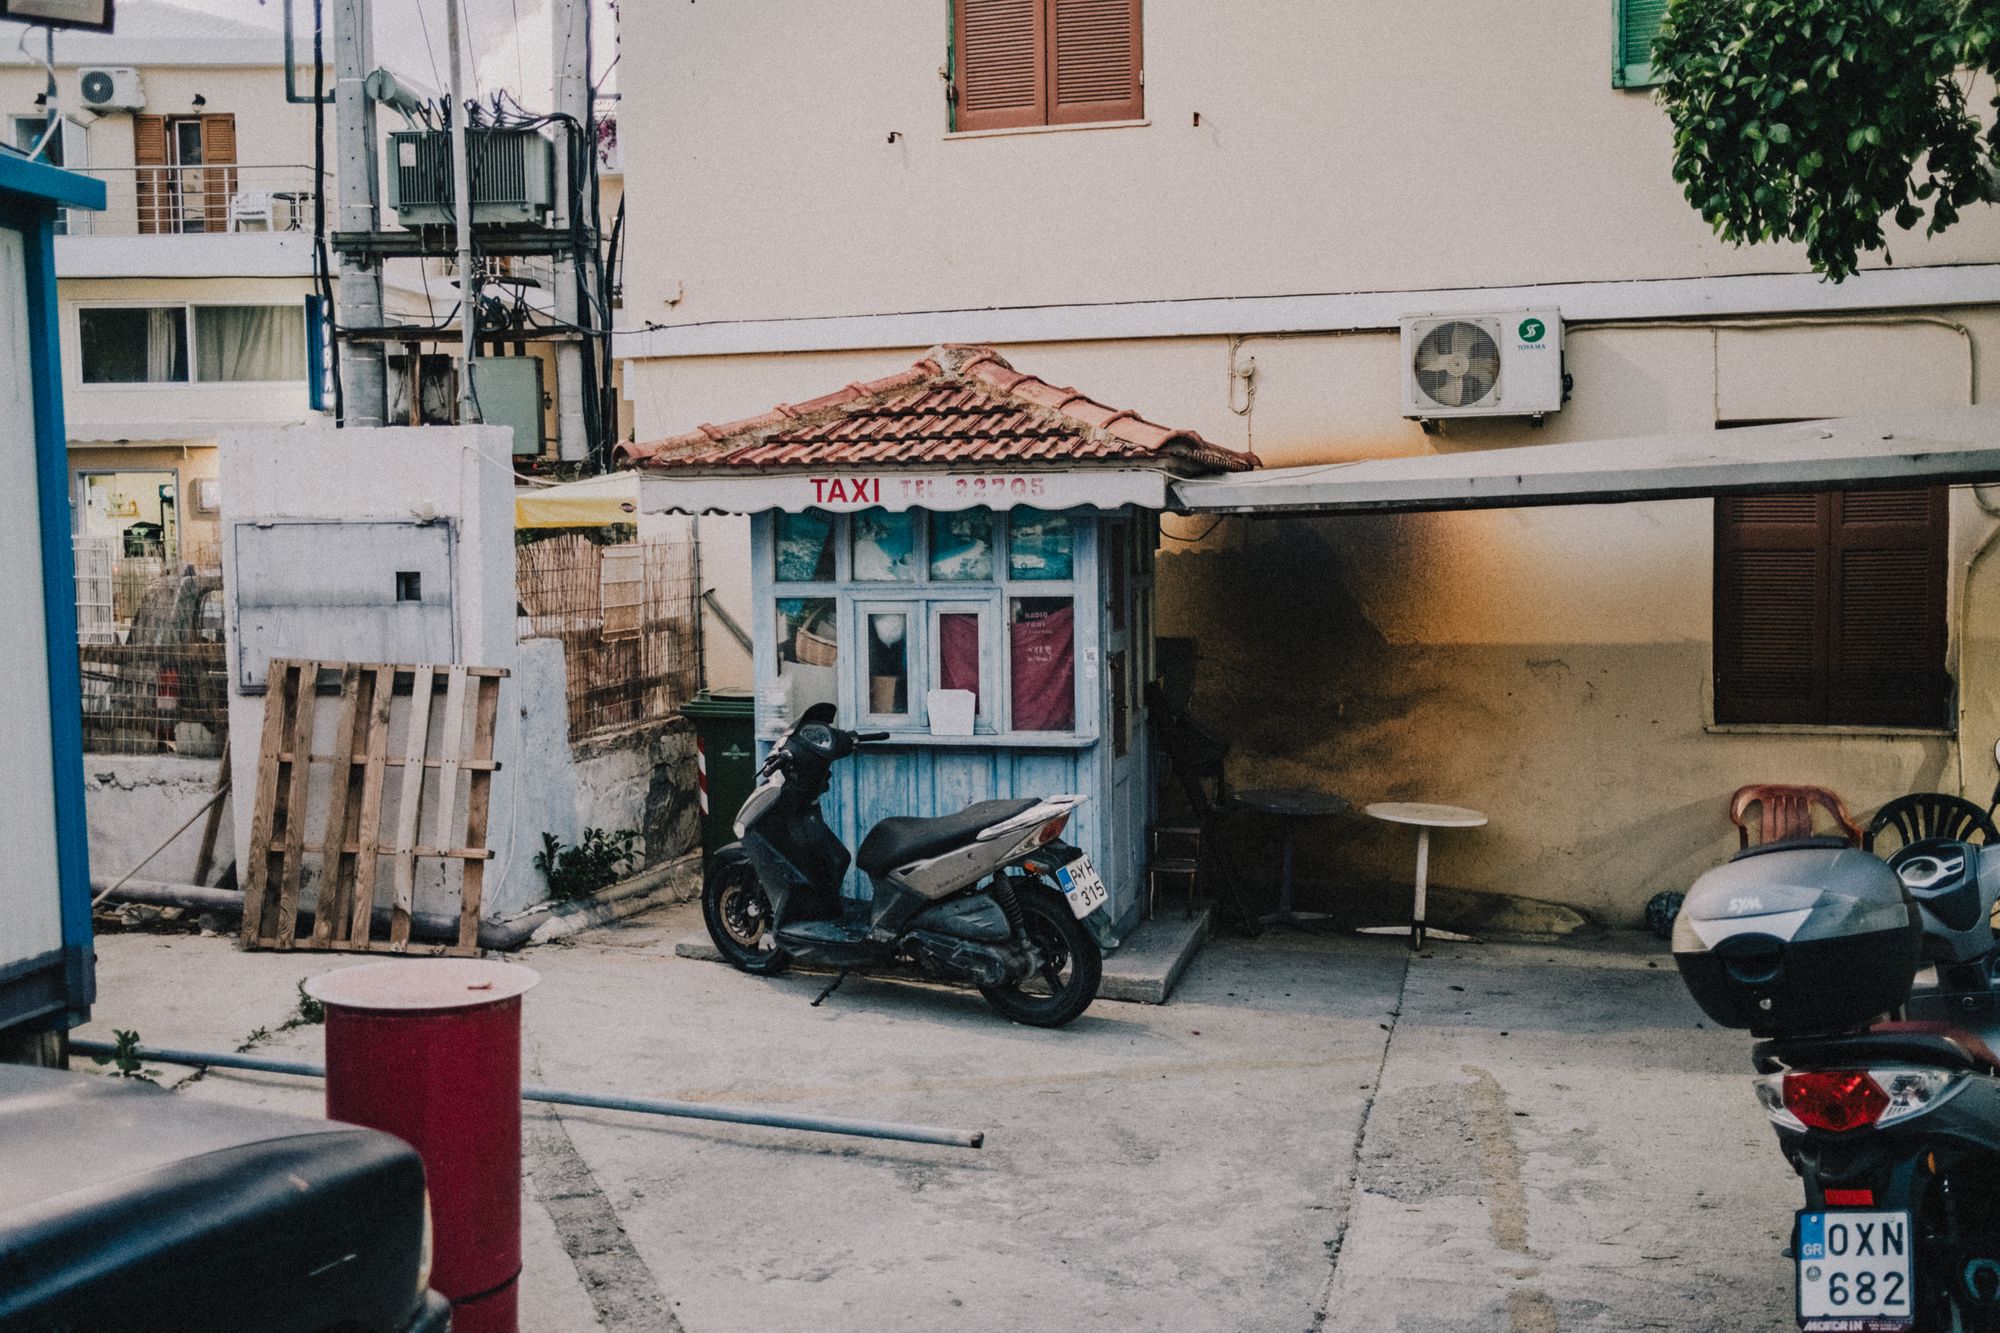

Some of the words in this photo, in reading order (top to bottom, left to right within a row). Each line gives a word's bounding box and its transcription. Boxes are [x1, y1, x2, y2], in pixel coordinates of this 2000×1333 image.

[810, 478, 880, 503] TAXI
[956, 478, 1045, 498] 22705
[1081, 880, 1105, 906] 315
[1803, 1243, 1823, 1256] GR
[1829, 1222, 1904, 1256] OXN
[1829, 1271, 1905, 1306] 682
